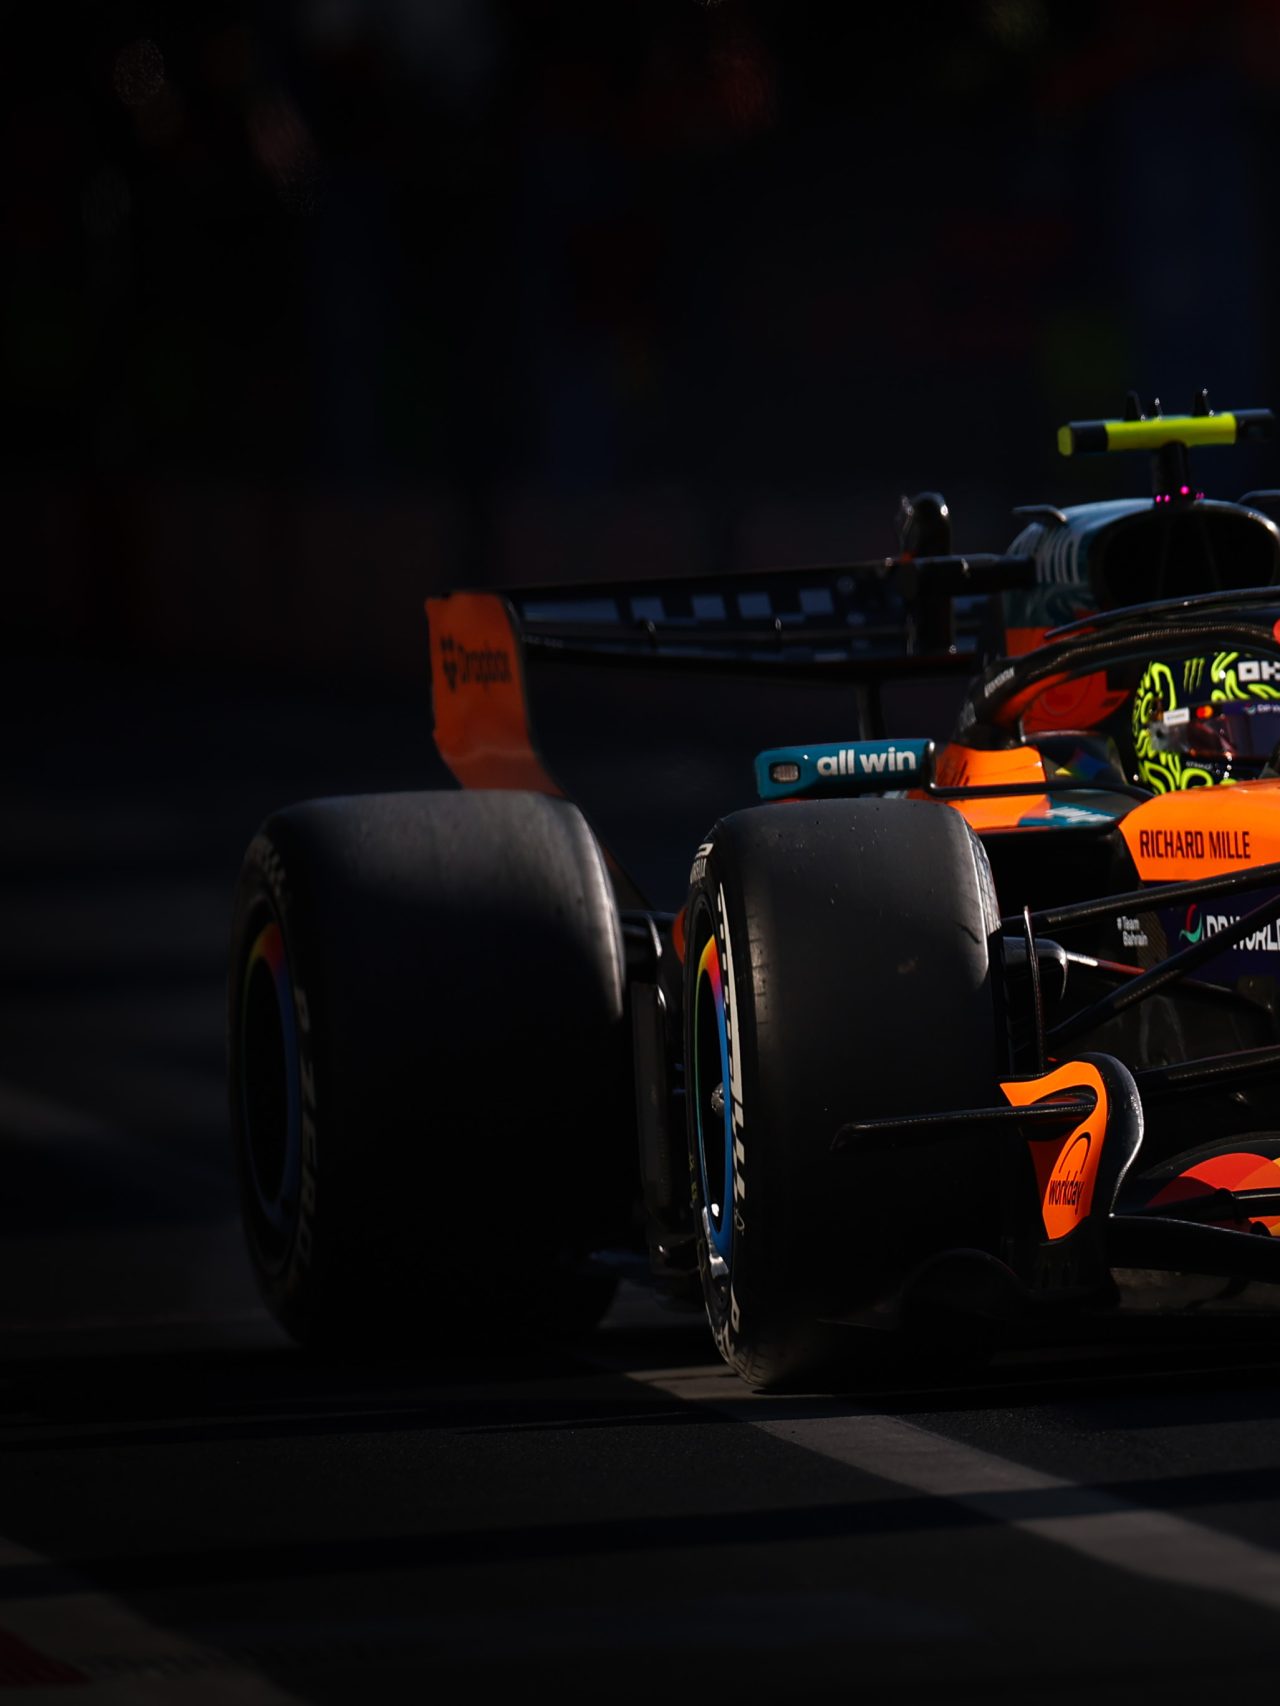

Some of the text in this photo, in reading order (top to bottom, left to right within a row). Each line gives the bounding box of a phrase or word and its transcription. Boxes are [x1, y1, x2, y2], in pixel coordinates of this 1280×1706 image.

[817, 746, 917, 776] all win
[1139, 830, 1251, 859] RICHARD MILLE
[1048, 1170, 1085, 1215] workday
